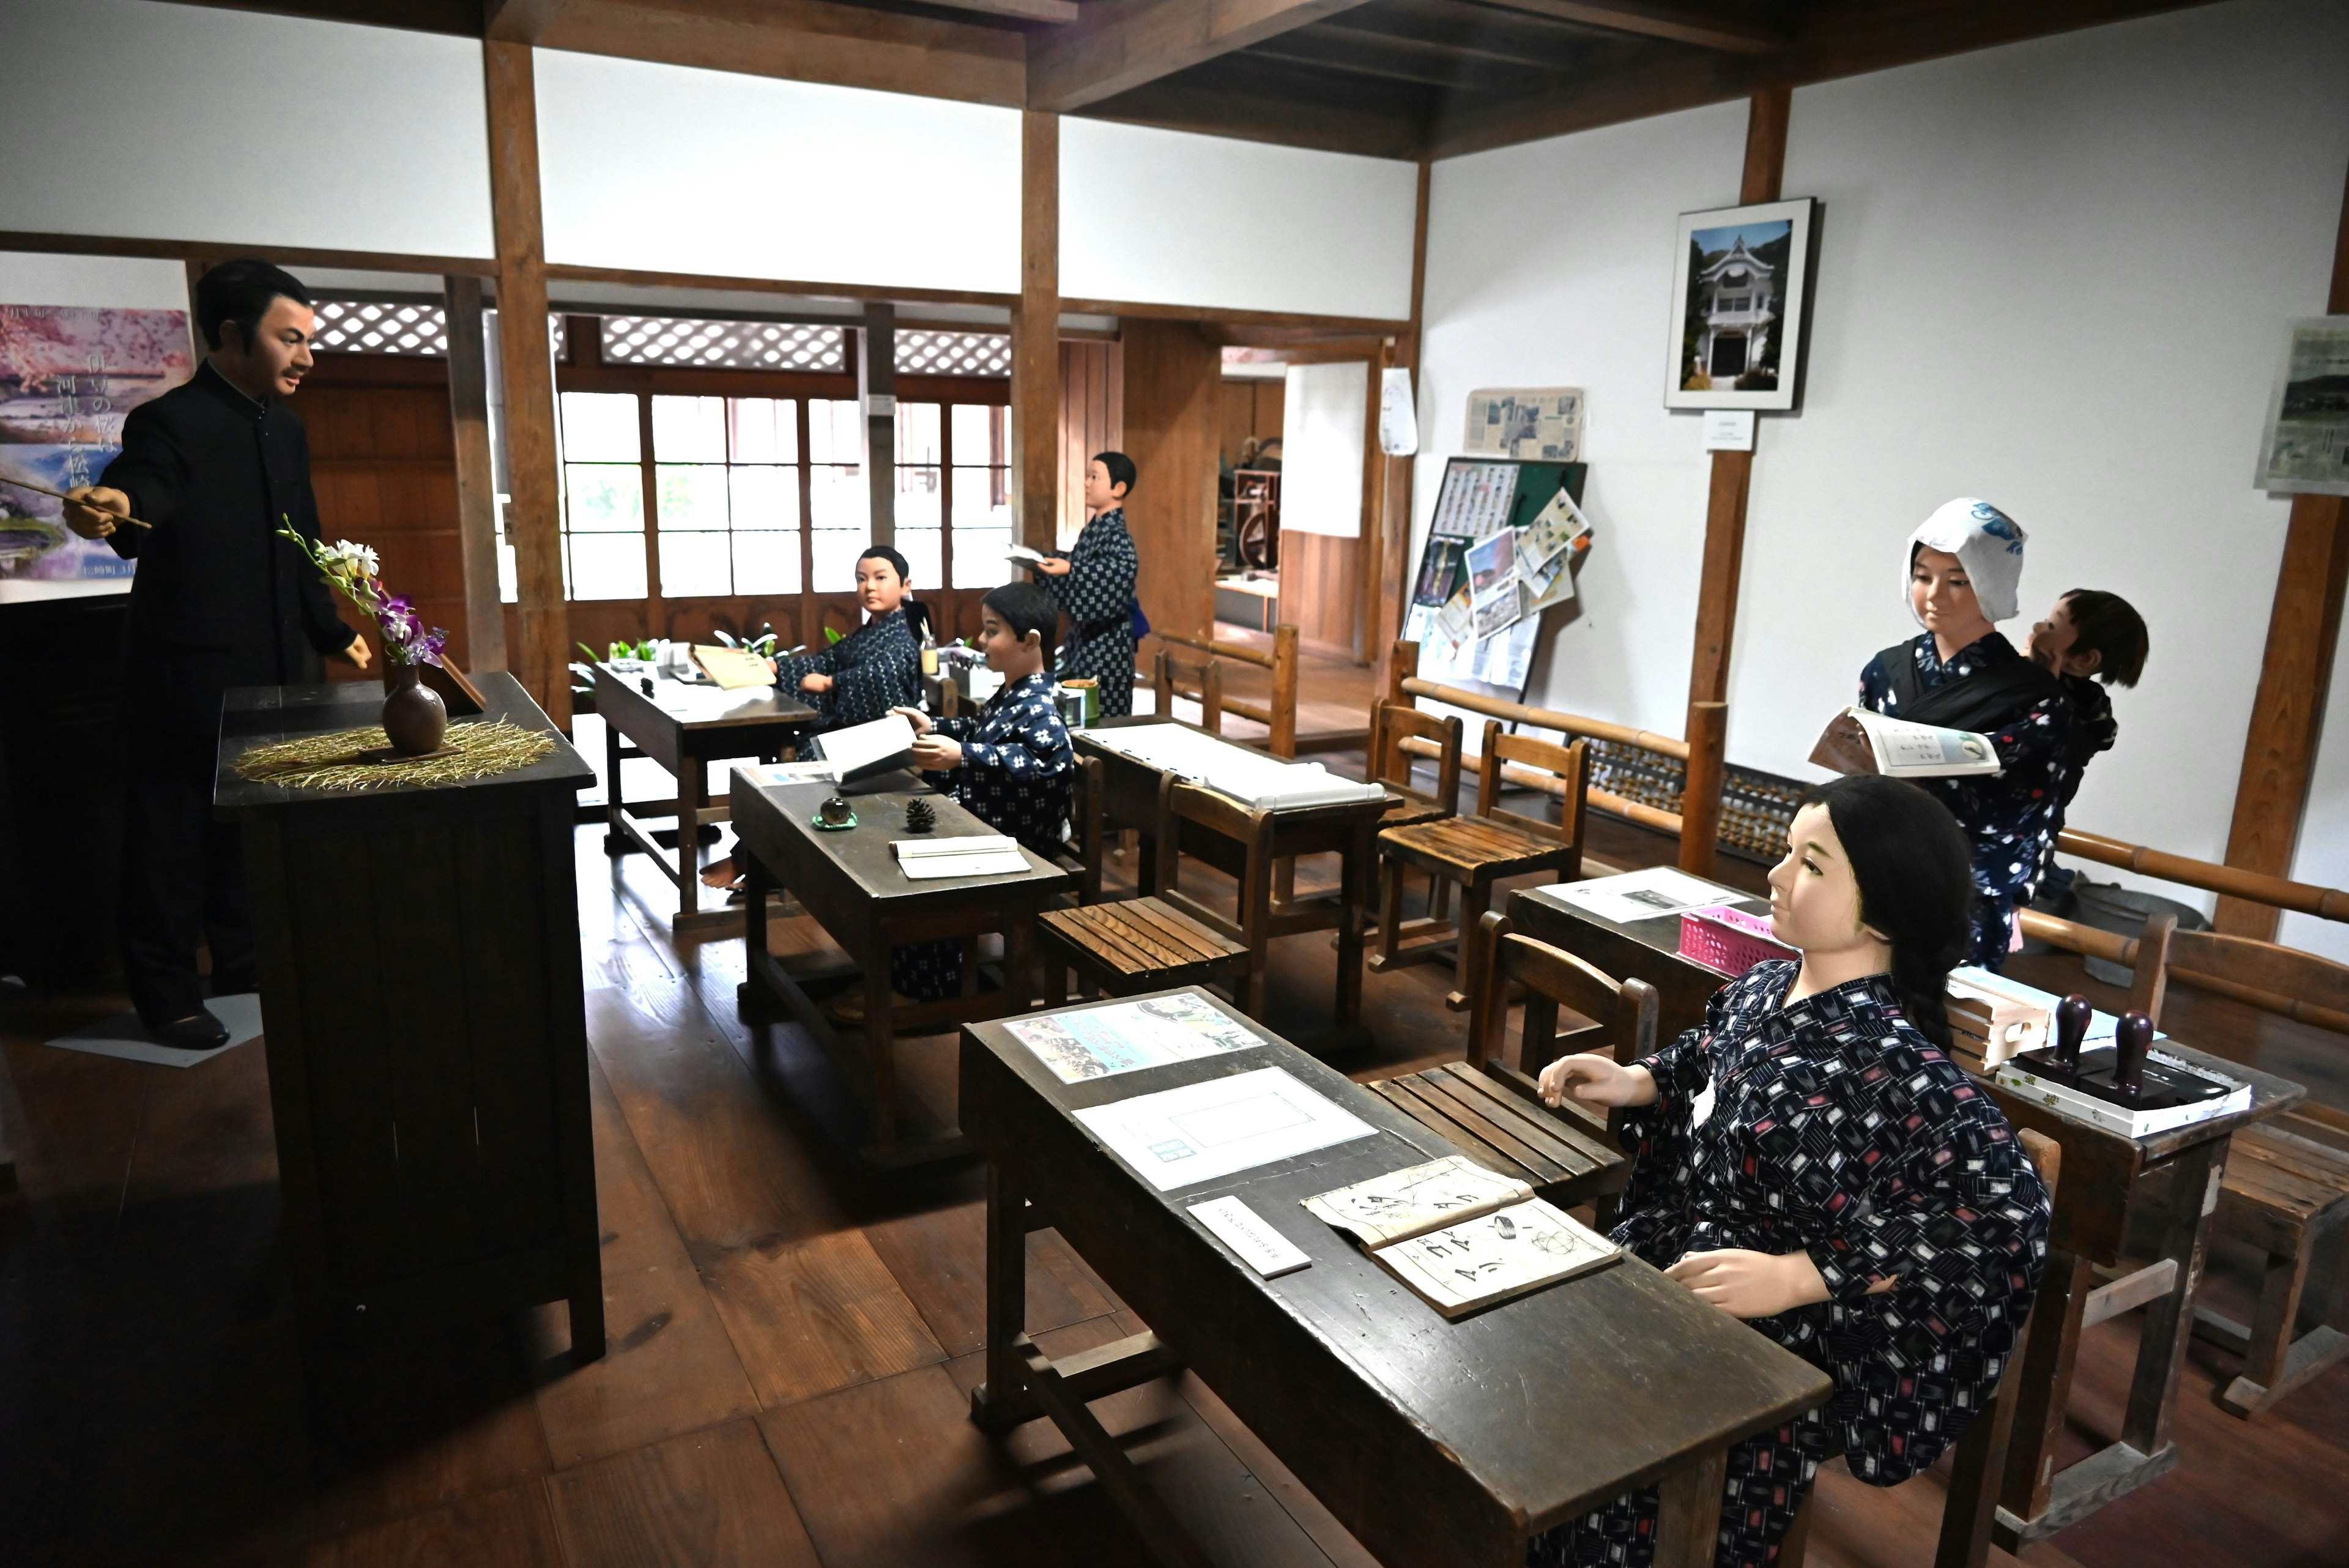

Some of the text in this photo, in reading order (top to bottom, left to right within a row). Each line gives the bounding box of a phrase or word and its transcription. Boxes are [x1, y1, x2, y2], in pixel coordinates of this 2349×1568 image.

[1219, 1208, 1282, 1260] 手をふれないで下さい
